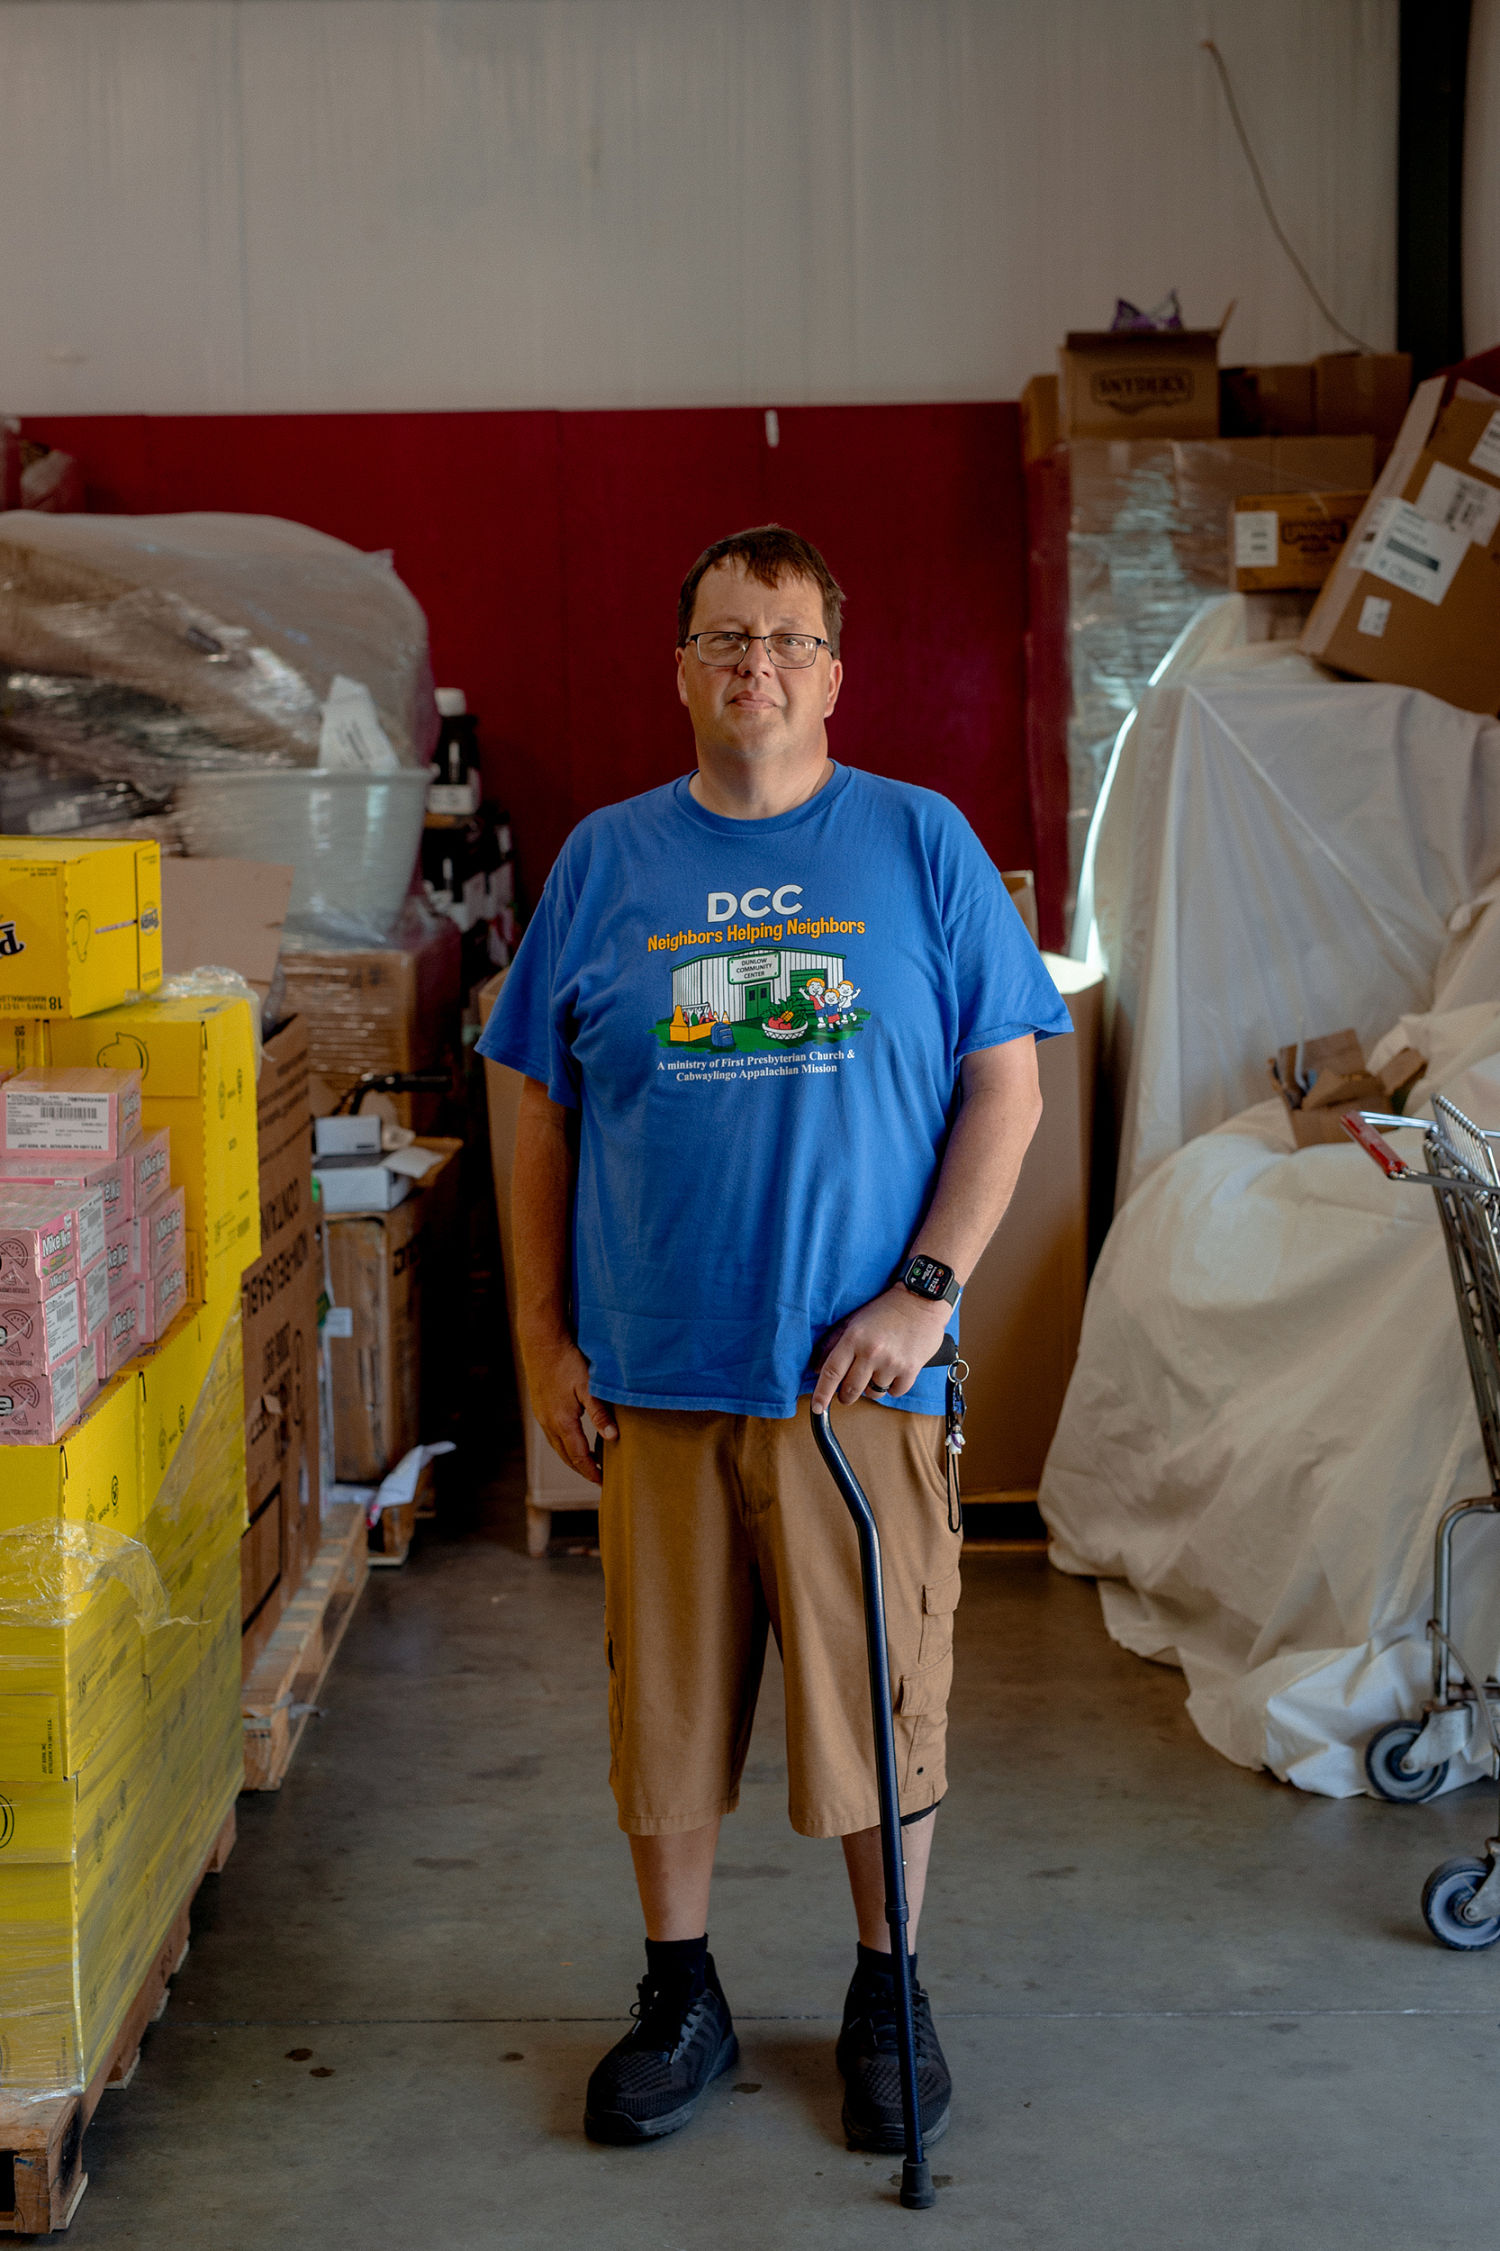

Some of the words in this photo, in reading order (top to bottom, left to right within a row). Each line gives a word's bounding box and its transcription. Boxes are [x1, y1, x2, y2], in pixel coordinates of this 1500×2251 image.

[707, 884, 803, 923] DCC
[647, 930, 723, 952] Neighbors
[727, 922, 783, 944] Helping
[786, 917, 865, 939] Neighbors
[736, 963, 773, 973] COMMUNITY
[741, 958, 768, 966] DUNLOW
[743, 971, 765, 979] CENTER
[49, 996, 63, 1011] 18
[657, 1061, 665, 1071] A
[667, 1059, 707, 1073] ministry
[709, 1058, 720, 1069] of
[721, 1057, 744, 1068] First
[747, 1053, 807, 1066] Presbyterian
[809, 1050, 844, 1061] Church
[846, 1049, 856, 1059] &
[676, 1071, 737, 1082] Cabwaylingo
[739, 1067, 799, 1079] Appalachian
[801, 1064, 837, 1074] Mission
[42, 1234, 61, 1259] Mike
[61, 1230, 71, 1249] Ike
